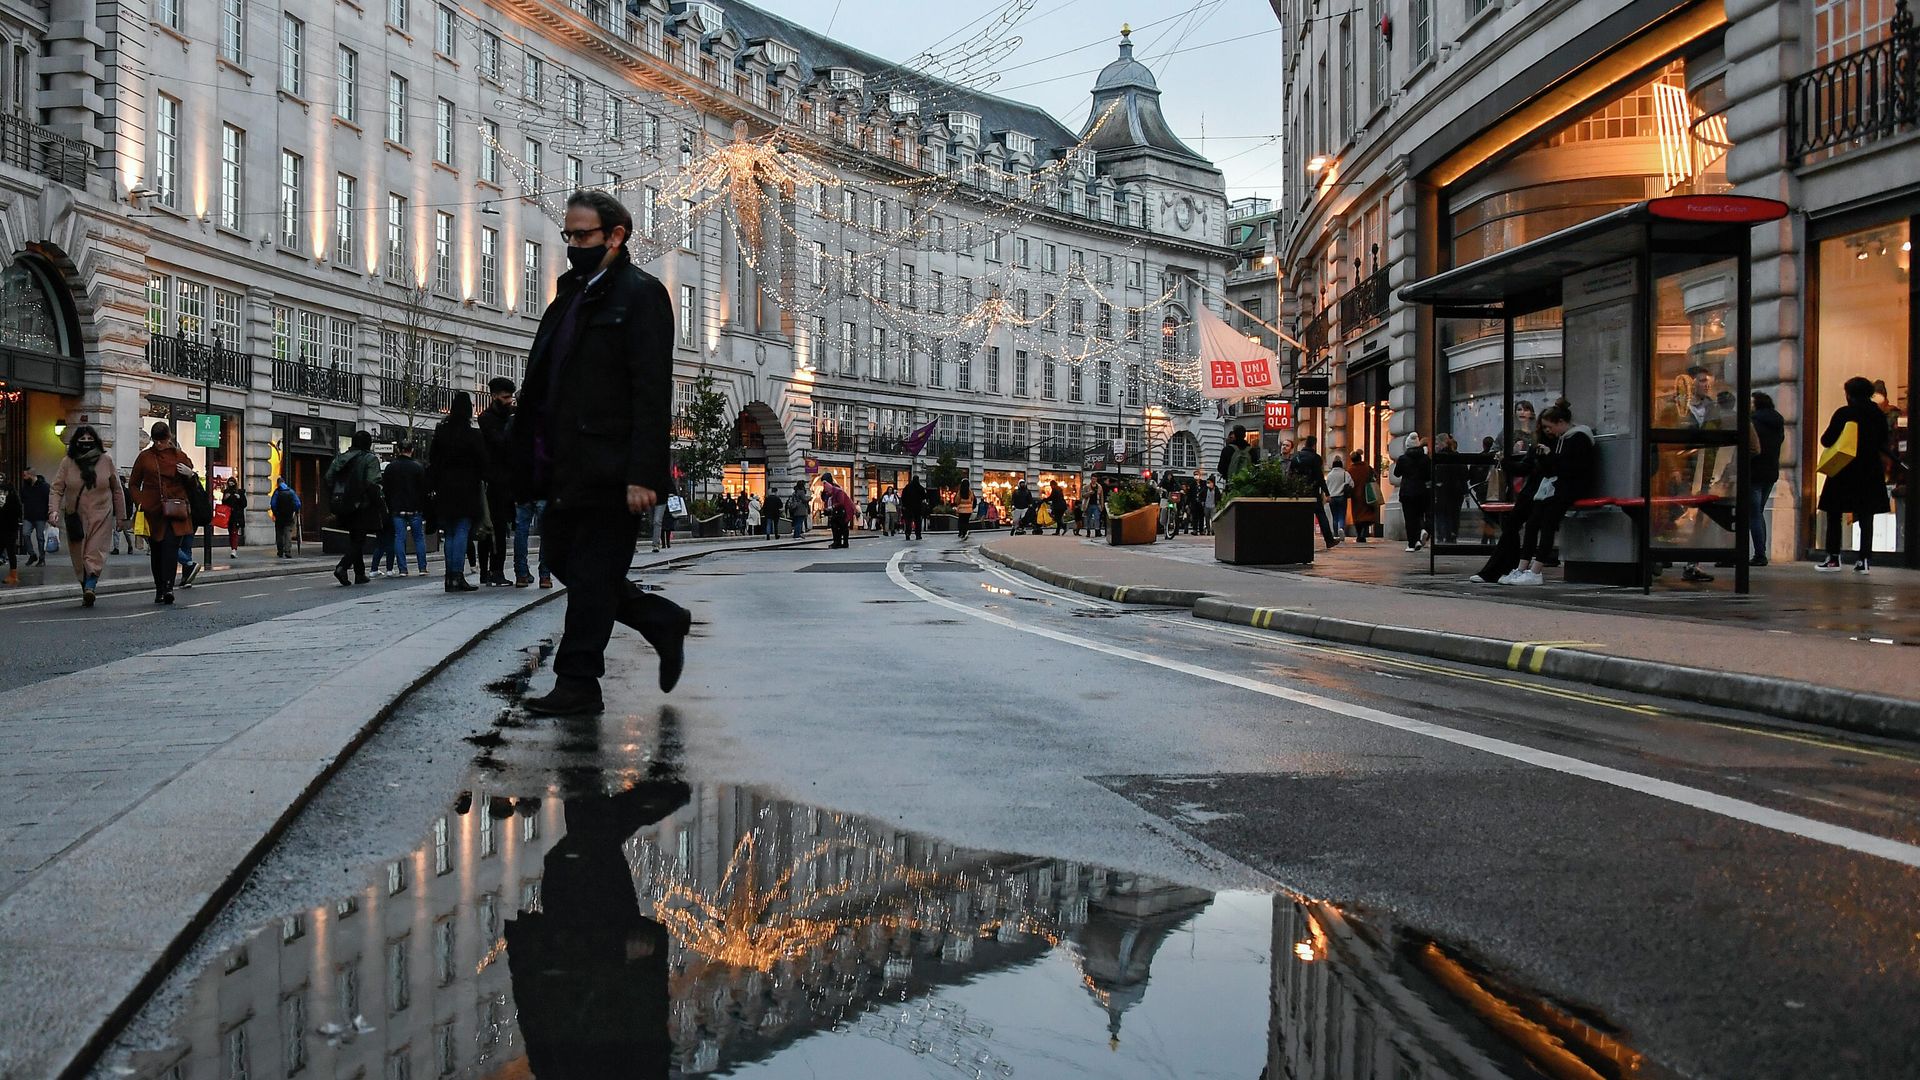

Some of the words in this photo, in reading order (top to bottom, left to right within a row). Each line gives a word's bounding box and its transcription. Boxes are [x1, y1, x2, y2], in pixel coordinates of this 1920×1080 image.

[1245, 362, 1264, 373] UNI
[1247, 373, 1267, 385] QLO
[1268, 406, 1286, 416] UNI
[1268, 417, 1288, 427] QLO
